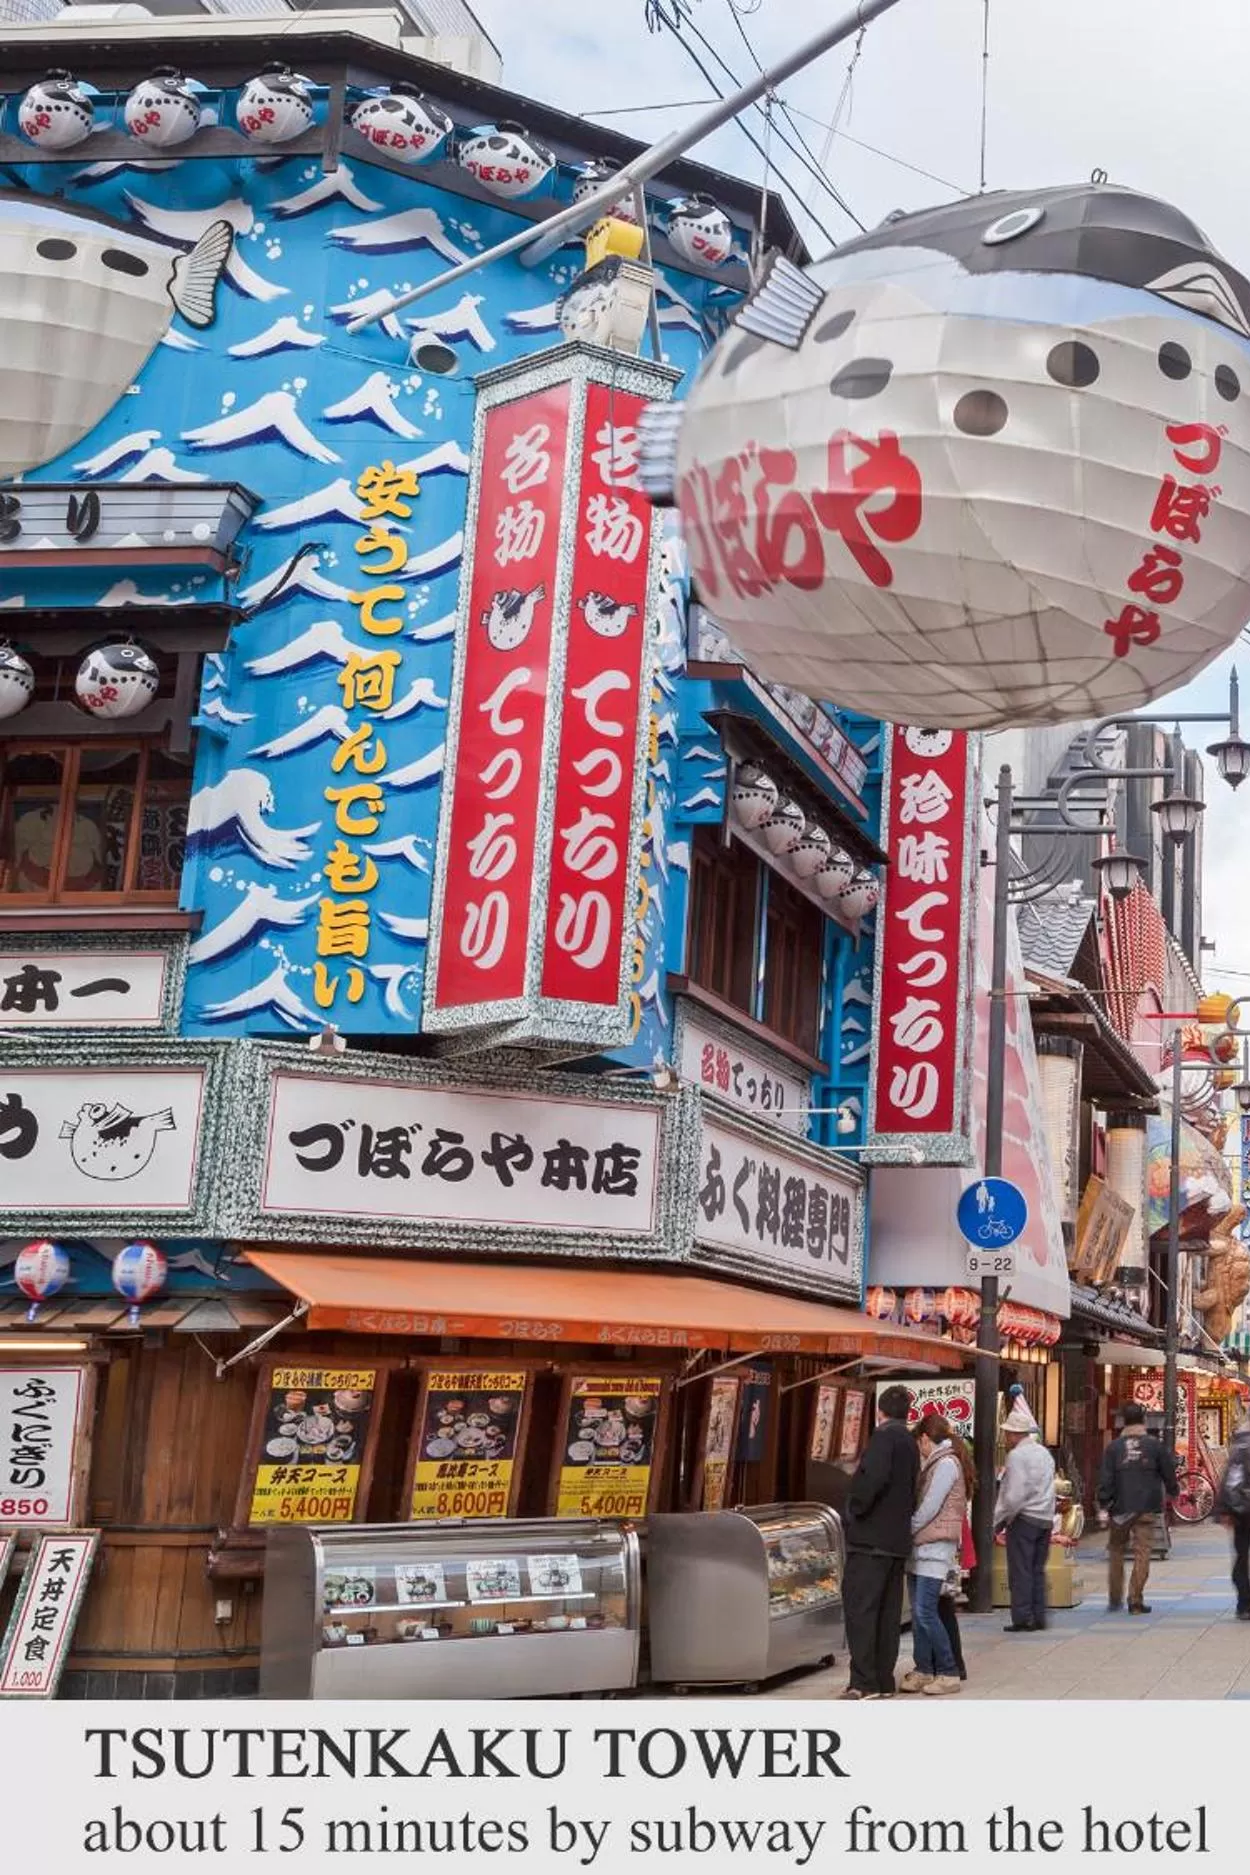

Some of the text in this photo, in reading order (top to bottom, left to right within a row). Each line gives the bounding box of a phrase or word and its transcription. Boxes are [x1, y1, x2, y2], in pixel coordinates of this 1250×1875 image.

[1103, 422, 1229, 658] づぼらや
[312, 460, 419, 1008] 安うて何んでも旨い
[459, 423, 553, 970] 名物 てっちり
[553, 669, 634, 970] てっちり
[889, 768, 955, 1121] 珍味てっちり
[700, 1042, 785, 1118] 名物てっちり
[287, 1119, 642, 1198] づぼらや本店
[700, 1142, 850, 1266] ふぐ料理専門
[969, 1257, 1013, 1272] 9-22
[280, 1496, 352, 1520] 5,400円
[437, 1490, 506, 1516] 8,600円
[23, 1548, 77, 1663] 天丼定食
